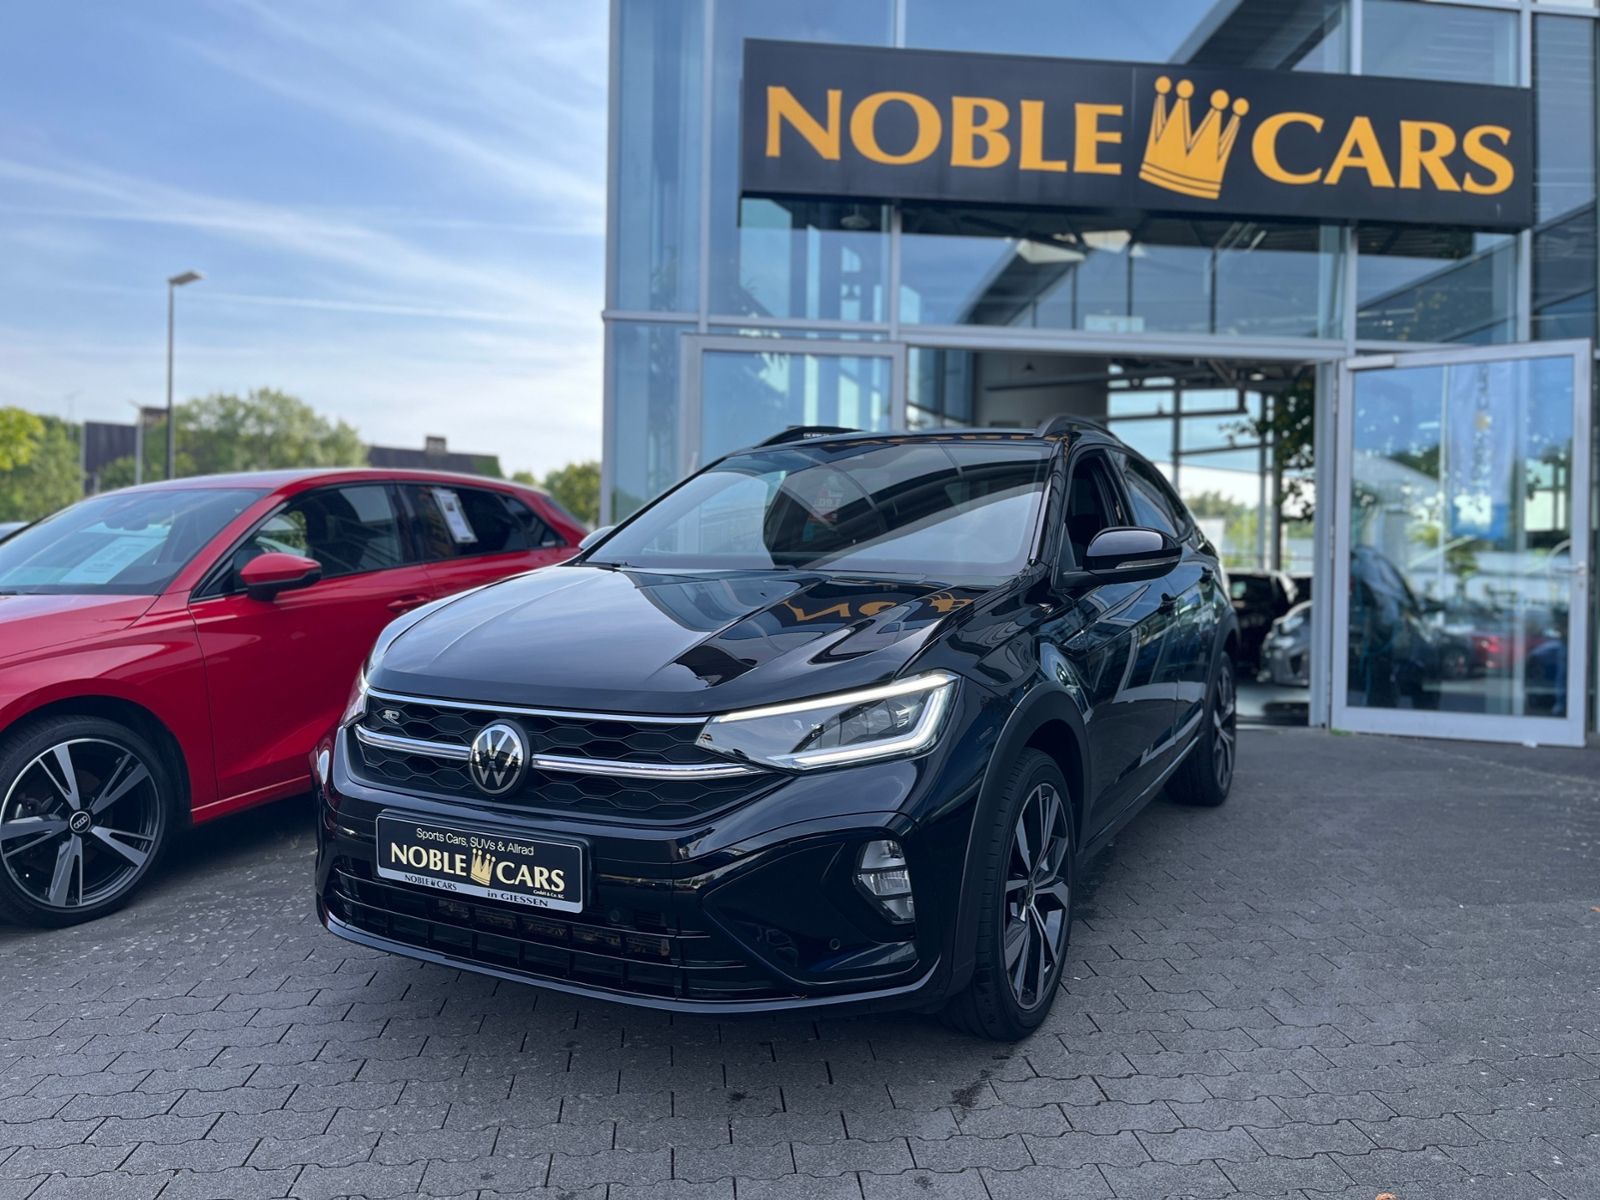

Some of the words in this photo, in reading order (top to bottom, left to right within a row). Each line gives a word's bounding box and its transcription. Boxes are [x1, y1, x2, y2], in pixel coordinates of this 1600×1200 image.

[766, 86, 1123, 175] NOBLE
[1251, 112, 1515, 195] CARS
[416, 828, 444, 842] Sports
[445, 833, 469, 847] Cars,
[470, 837, 496, 851] SUVs
[497, 841, 505, 852] &
[507, 842, 534, 855] Allrad
[391, 842, 467, 876] NOBLE
[496, 861, 565, 892] CARS
[404, 874, 430, 885] NOBLE
[436, 880, 457, 891] CARS
[487, 890, 498, 898] in
[500, 892, 549, 907] GIESSEN
